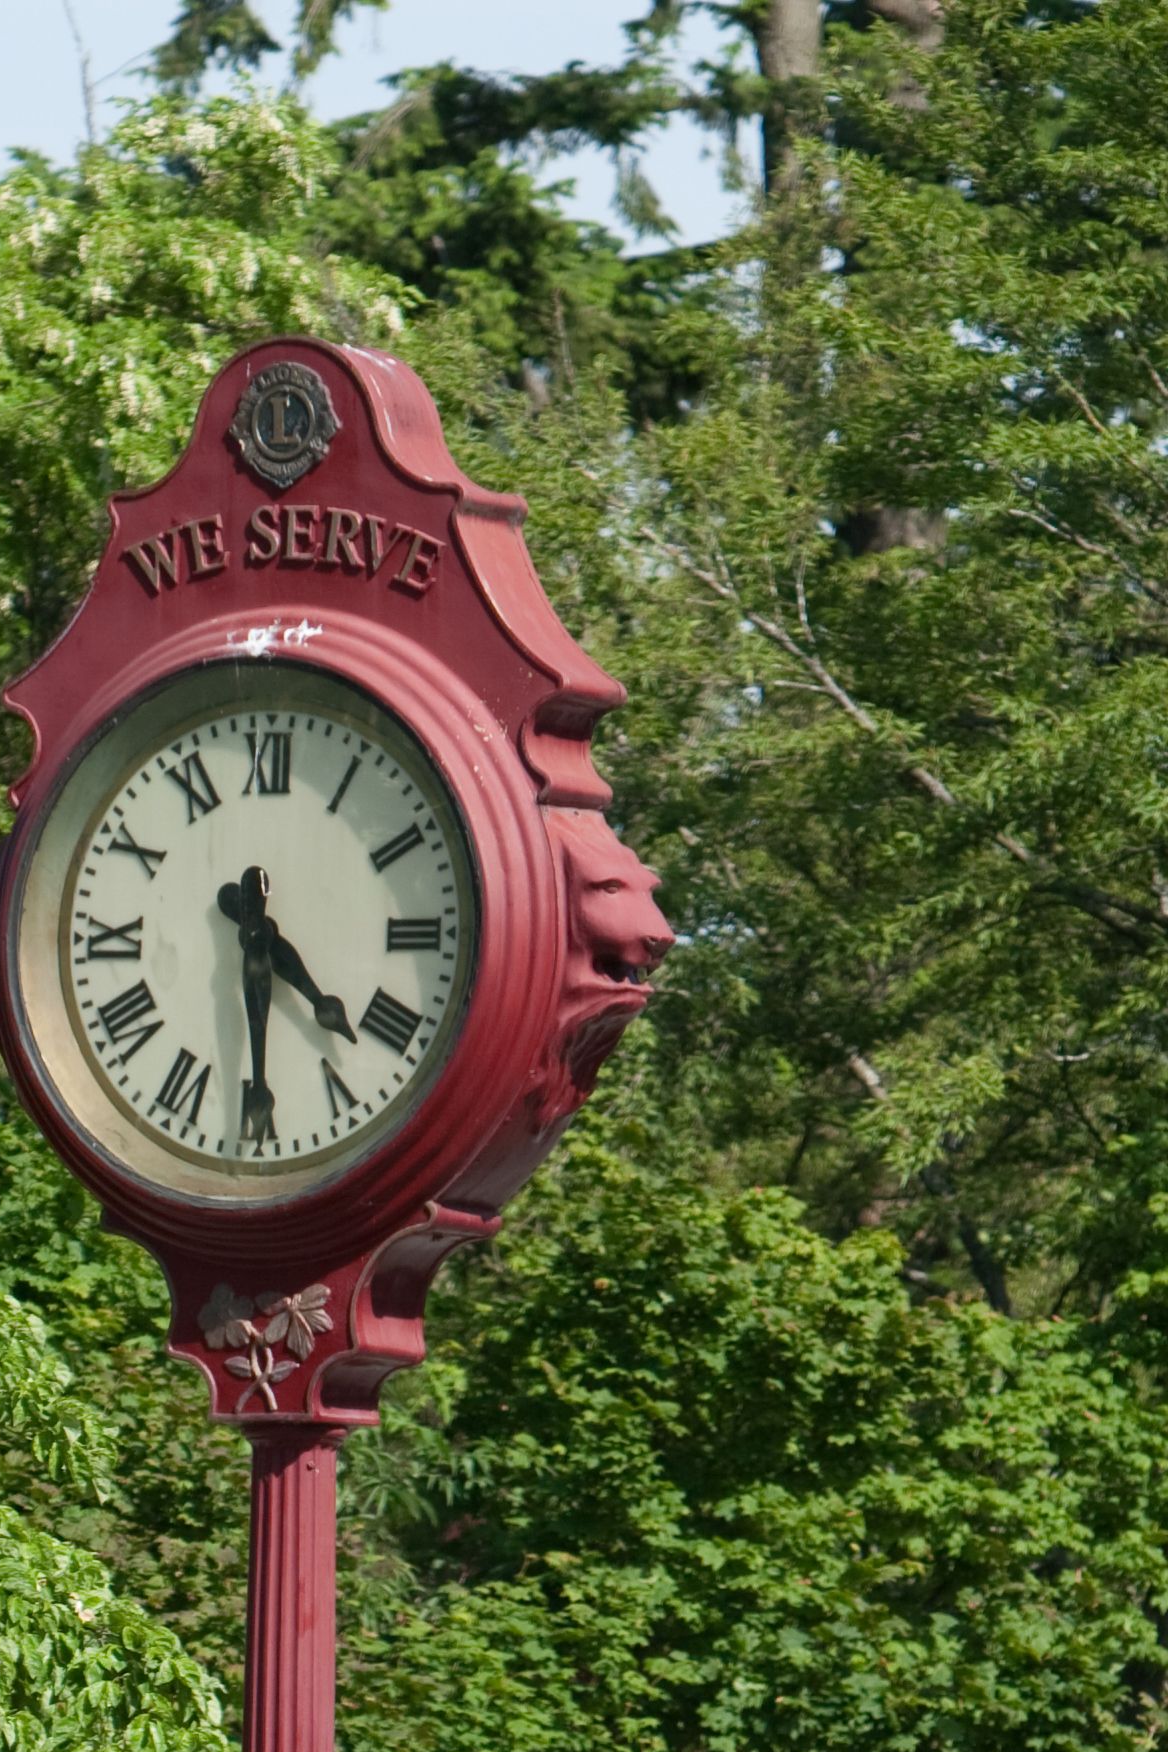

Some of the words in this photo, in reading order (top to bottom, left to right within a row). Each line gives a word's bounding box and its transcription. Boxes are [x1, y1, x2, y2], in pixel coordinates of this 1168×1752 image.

[269, 394, 302, 446] L
[122, 513, 230, 594] WE
[248, 503, 447, 592] SERVE
[165, 751, 222, 824] XI
[243, 731, 293, 795] XII
[327, 755, 363, 814] I
[108, 823, 167, 879] X
[370, 823, 425, 873] II
[88, 916, 144, 960] IX
[386, 917, 442, 952] III
[98, 979, 165, 1065] VIII
[359, 987, 423, 1055] IIII
[156, 1047, 212, 1126] VII
[321, 1058, 360, 1119] V
